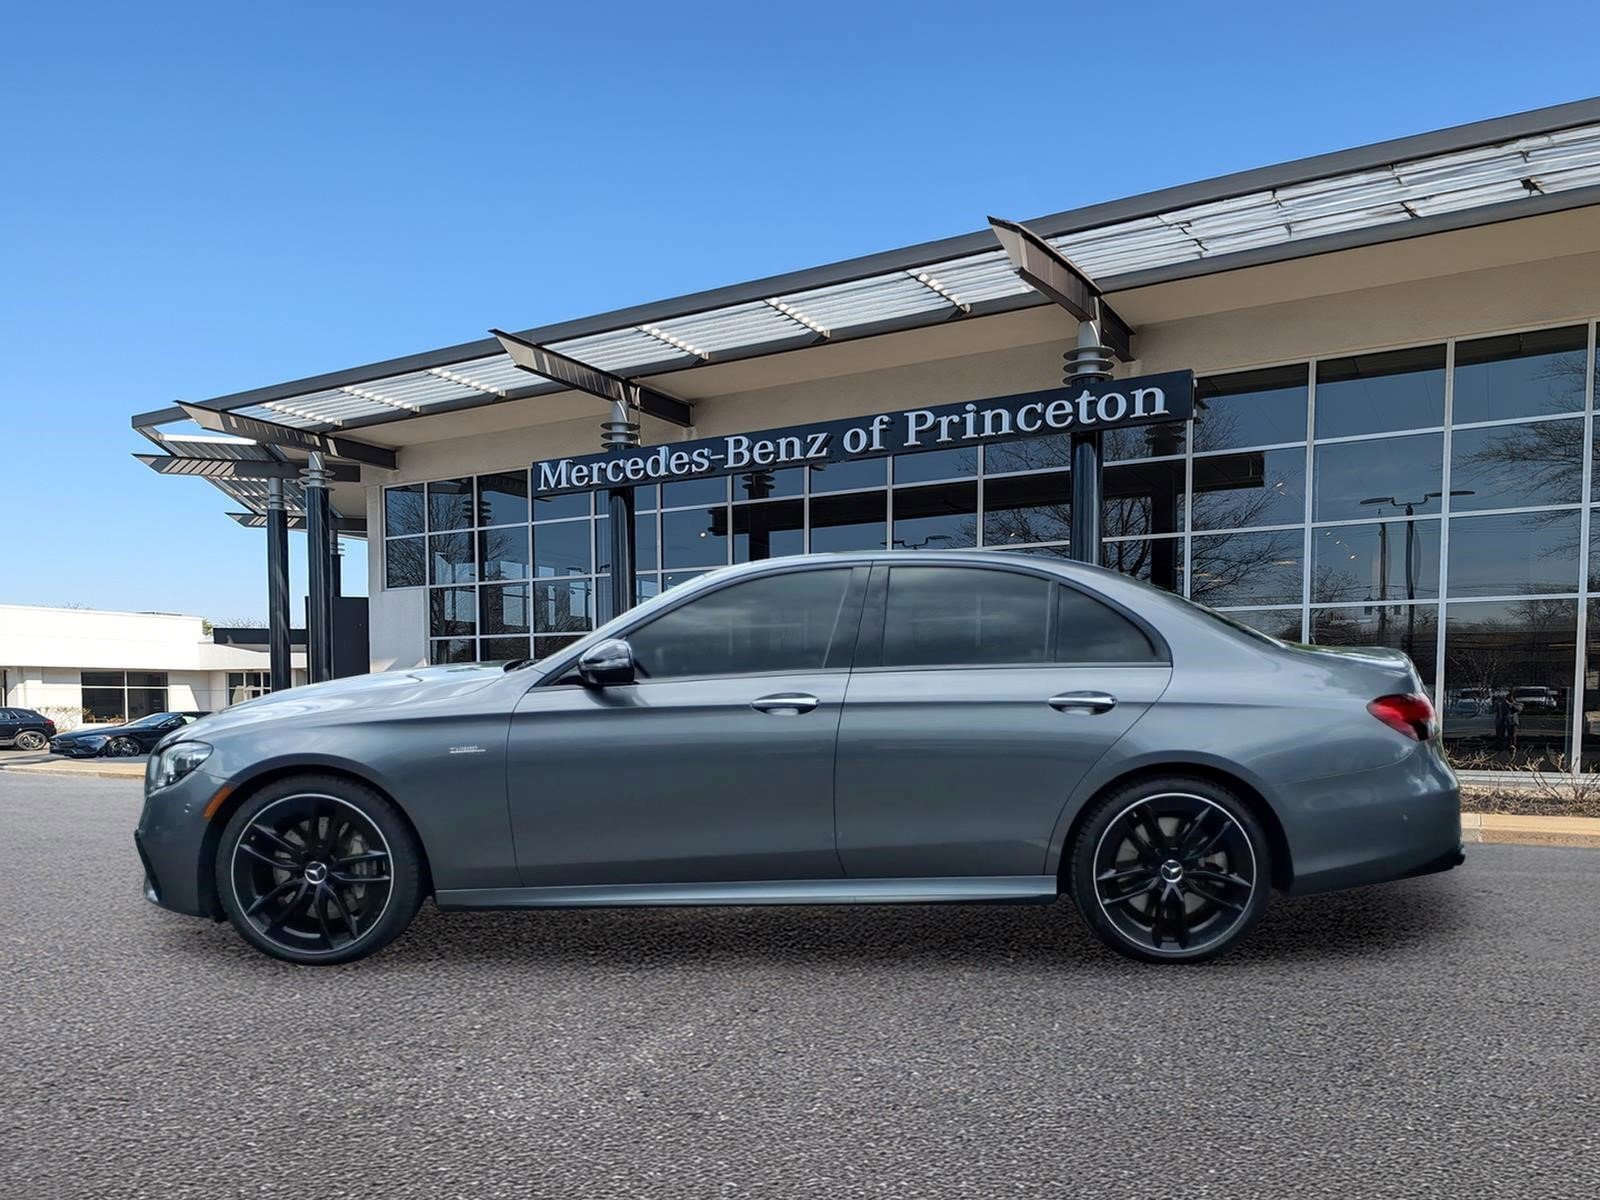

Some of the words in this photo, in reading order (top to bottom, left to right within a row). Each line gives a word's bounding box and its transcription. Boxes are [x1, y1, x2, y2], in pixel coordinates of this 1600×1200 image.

[537, 432, 830, 491] Mercedes-Benz
[843, 415, 890, 454] of
[903, 386, 1169, 447] Princeton
